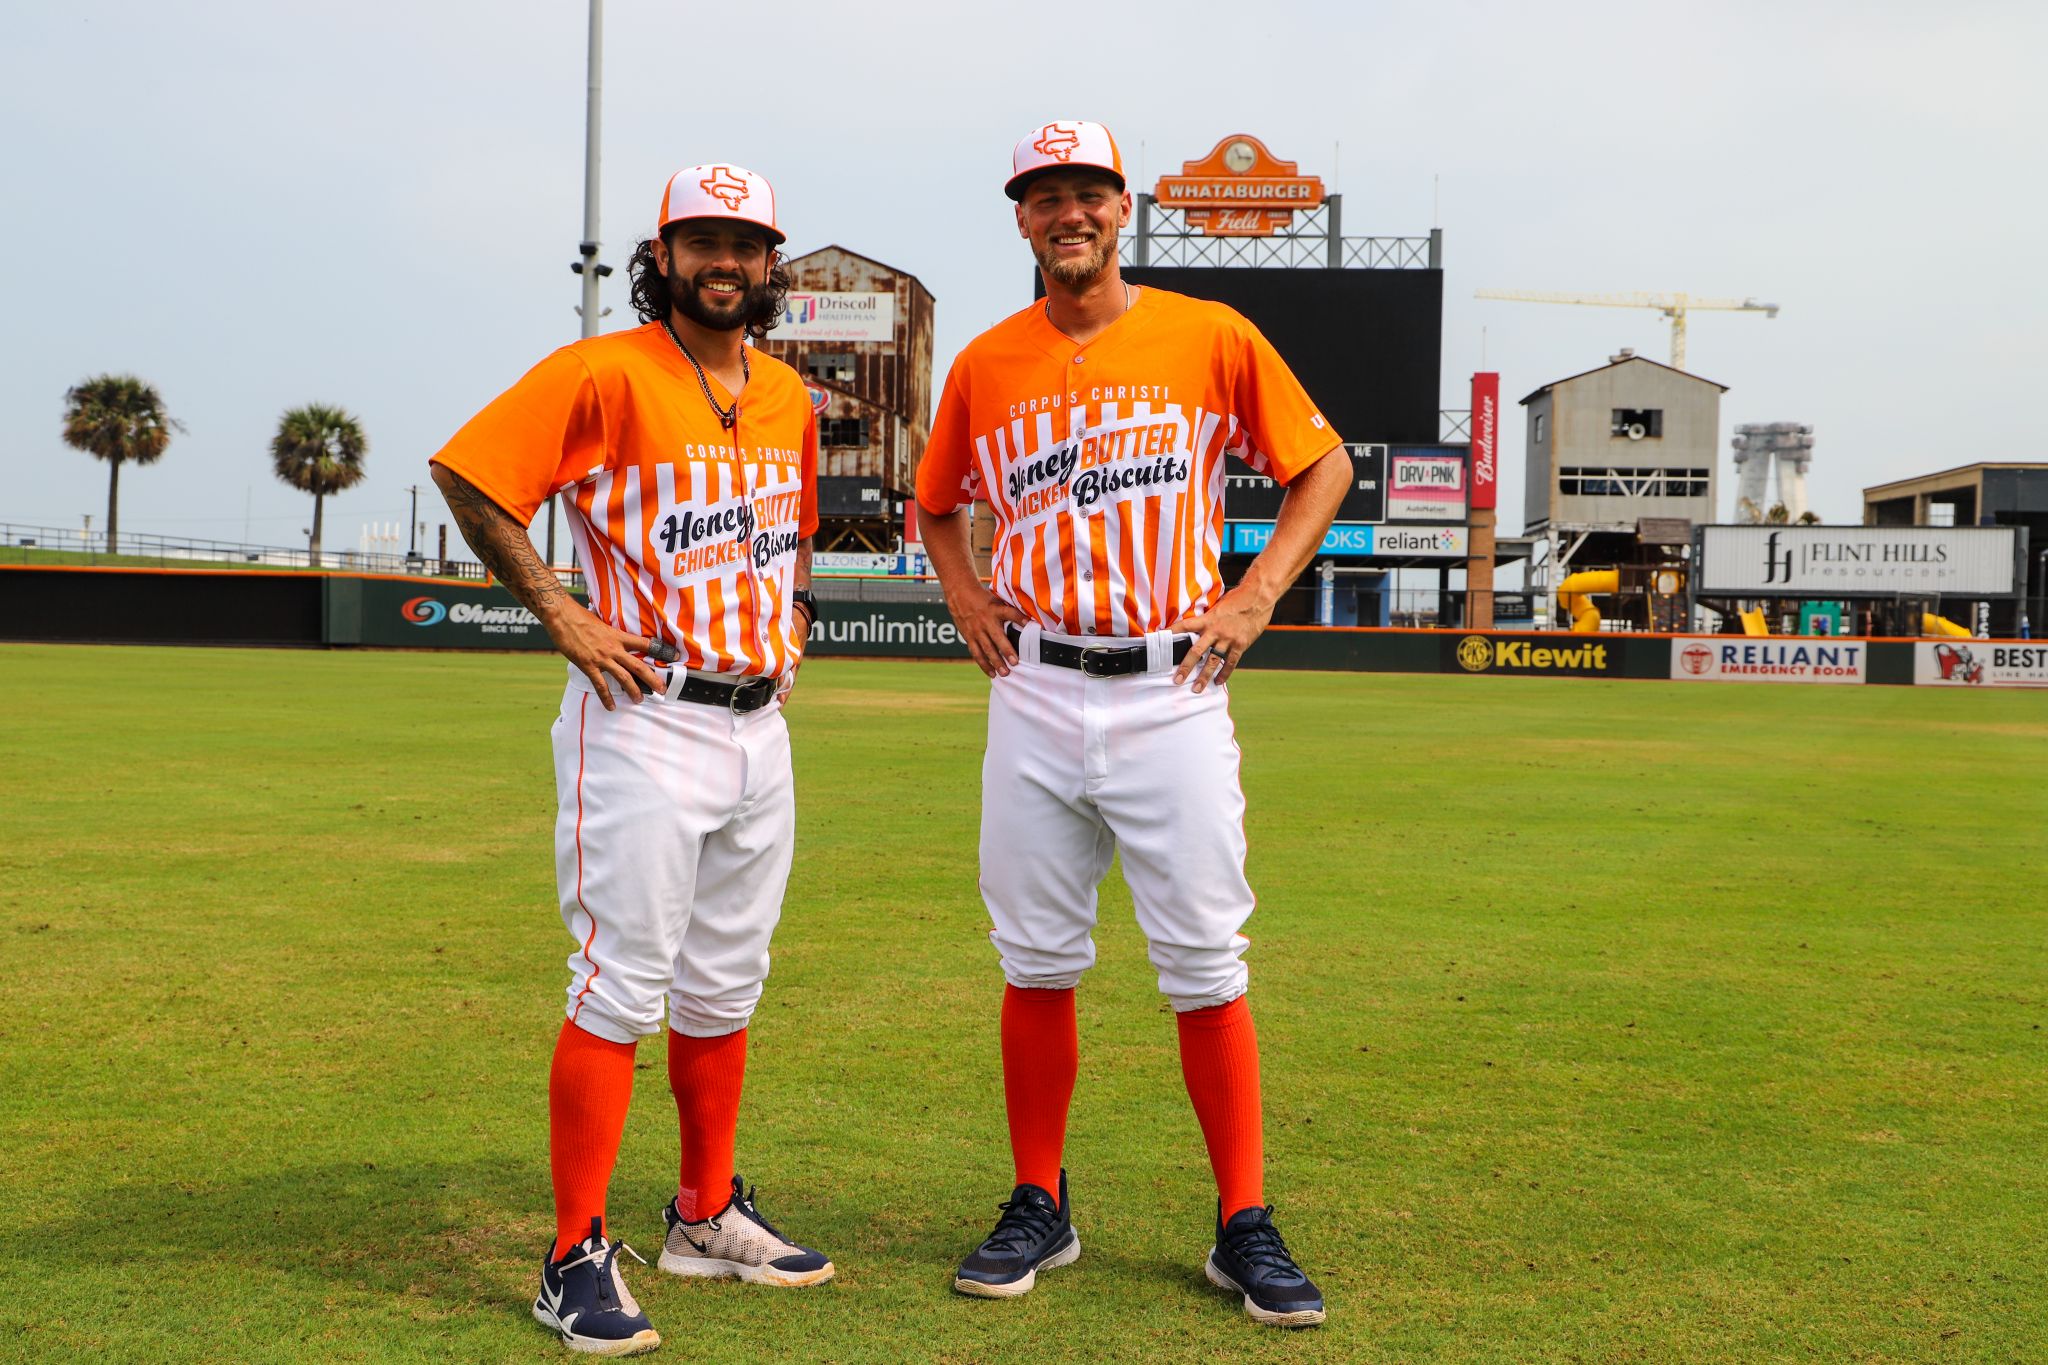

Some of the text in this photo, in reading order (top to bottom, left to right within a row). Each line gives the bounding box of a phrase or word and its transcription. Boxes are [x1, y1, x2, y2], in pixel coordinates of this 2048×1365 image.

[1168, 184, 1311, 199] WHATABURGER
[1216, 208, 1261, 230] Field
[819, 295, 876, 310] Driscoll
[819, 313, 876, 321] HEALTH PLAN
[1009, 385, 1169, 418] CORPUS CHRISTI
[1475, 395, 1494, 486] Budweiser
[686, 443, 800, 465] CORPUS CHRISTI
[1009, 422, 1179, 508] Honey BUTTER
[1400, 465, 1455, 483] DRV PNK
[1072, 456, 1188, 508] Biscuits
[1262, 479, 1273, 488] 10
[1359, 480, 1376, 490] ERR
[861, 488, 880, 501] MPH
[660, 490, 801, 553] Honey BUTTE
[1240, 528, 1366, 548] TH OKS
[1379, 532, 1439, 550] reliant
[673, 531, 798, 577] CHICKEN Biscu
[814, 555, 869, 567] LL ZONE
[1811, 543, 1948, 563] FLINT HILLS
[1810, 566, 1947, 578] resources
[481, 625, 508, 634] SINCE
[1496, 641, 1607, 669] Kiewit
[1721, 646, 1860, 666] RELIANT
[1994, 648, 2048, 668] BEST
[1721, 664, 1858, 676] EMERGENCY ROOM
